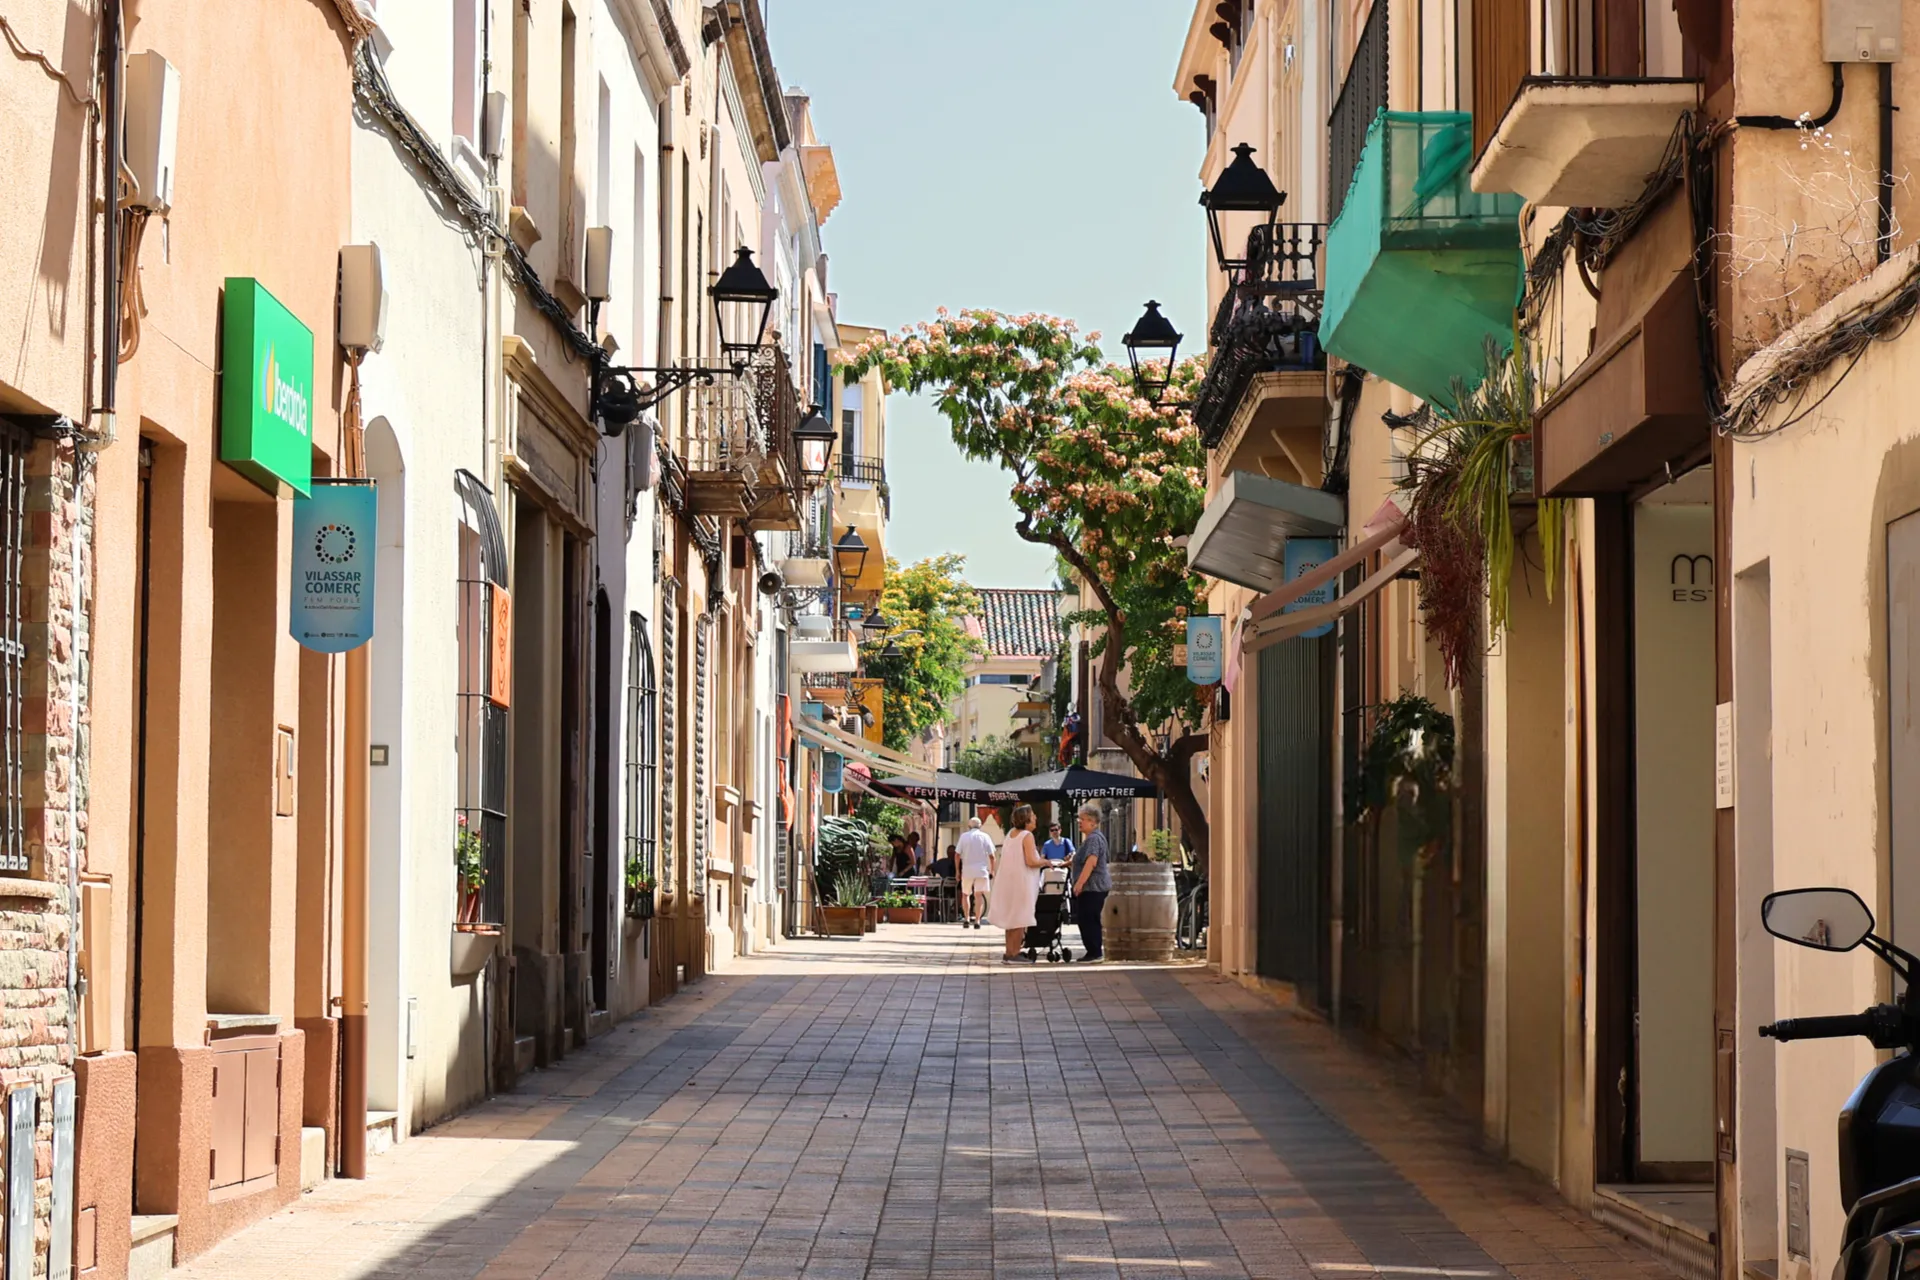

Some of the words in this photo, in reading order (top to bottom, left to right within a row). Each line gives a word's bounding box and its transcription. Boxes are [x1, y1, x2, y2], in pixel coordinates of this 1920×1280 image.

[274, 361, 307, 436] Iberdrola
[305, 571, 361, 581] VILASSAR
[305, 582, 360, 597] COMERÇ
[1075, 787, 1135, 797] FEVER-TREE
